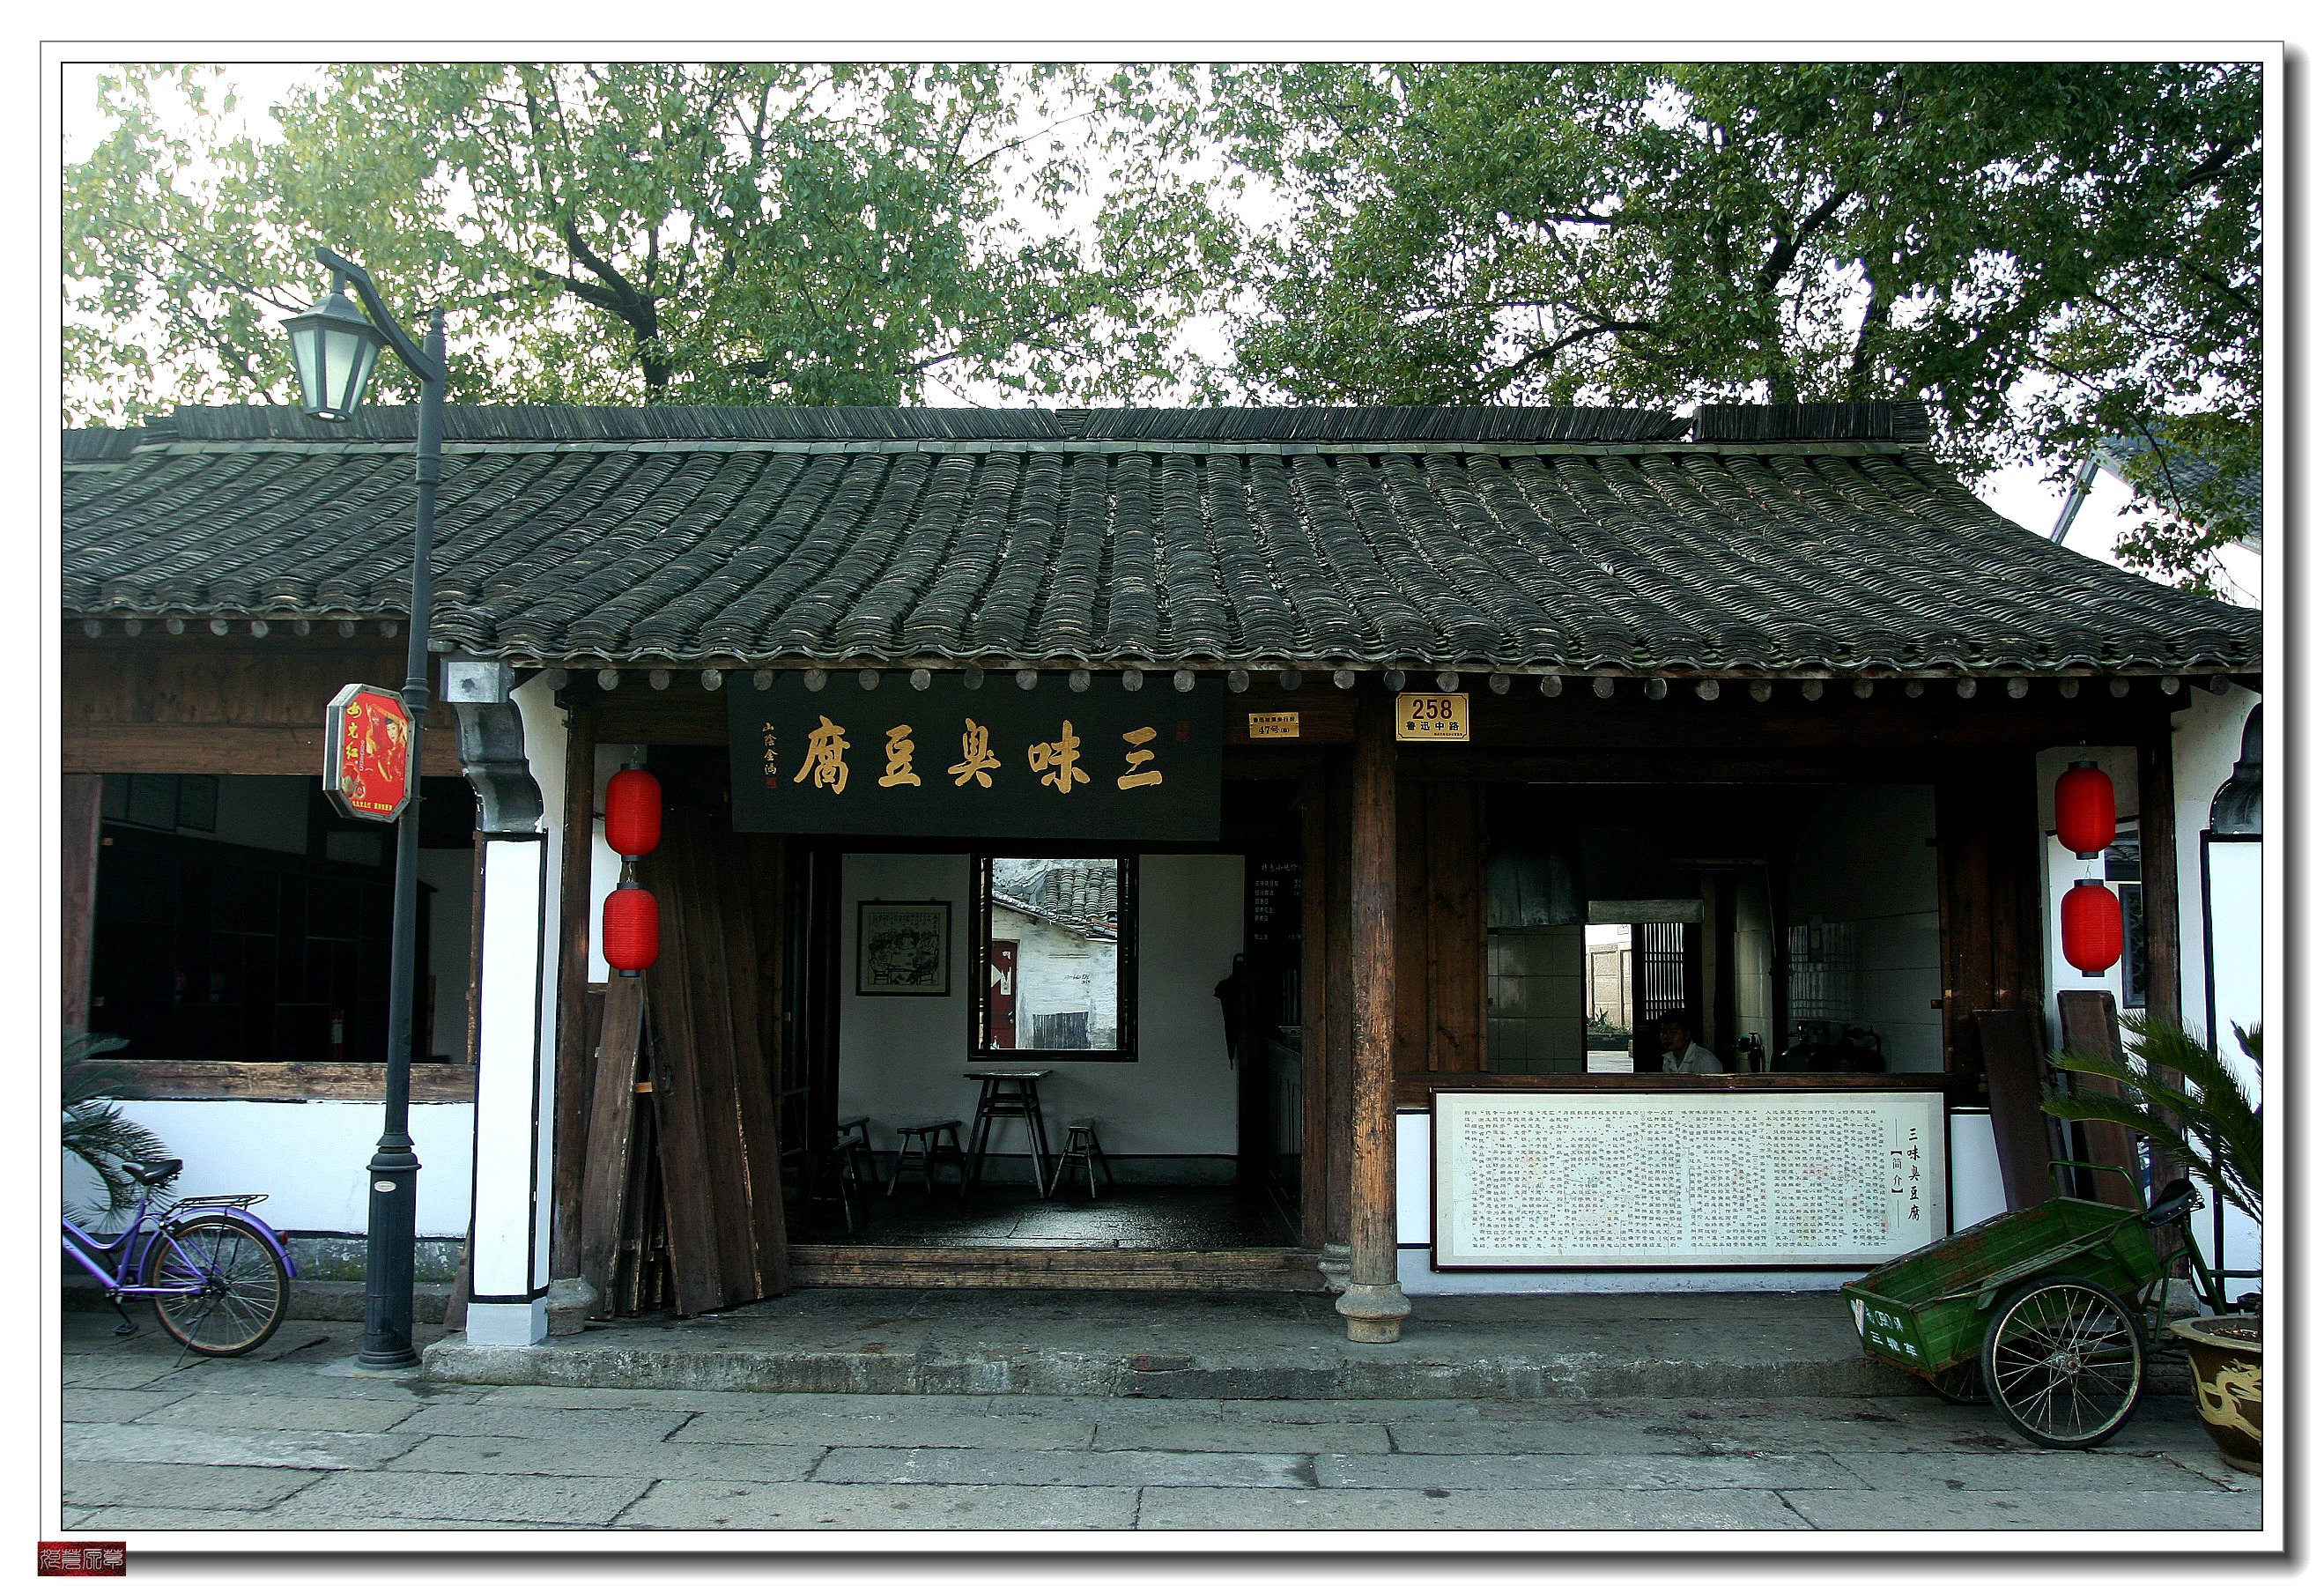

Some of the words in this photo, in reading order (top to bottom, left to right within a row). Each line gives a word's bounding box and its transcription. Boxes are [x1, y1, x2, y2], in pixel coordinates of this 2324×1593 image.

[1406, 721, 1460, 731] 鲁迅中路
[1412, 699, 1453, 720] 258
[793, 715, 1164, 795] 三味臭豆腐
[1906, 1128, 1921, 1221] 三味臭豆腐
